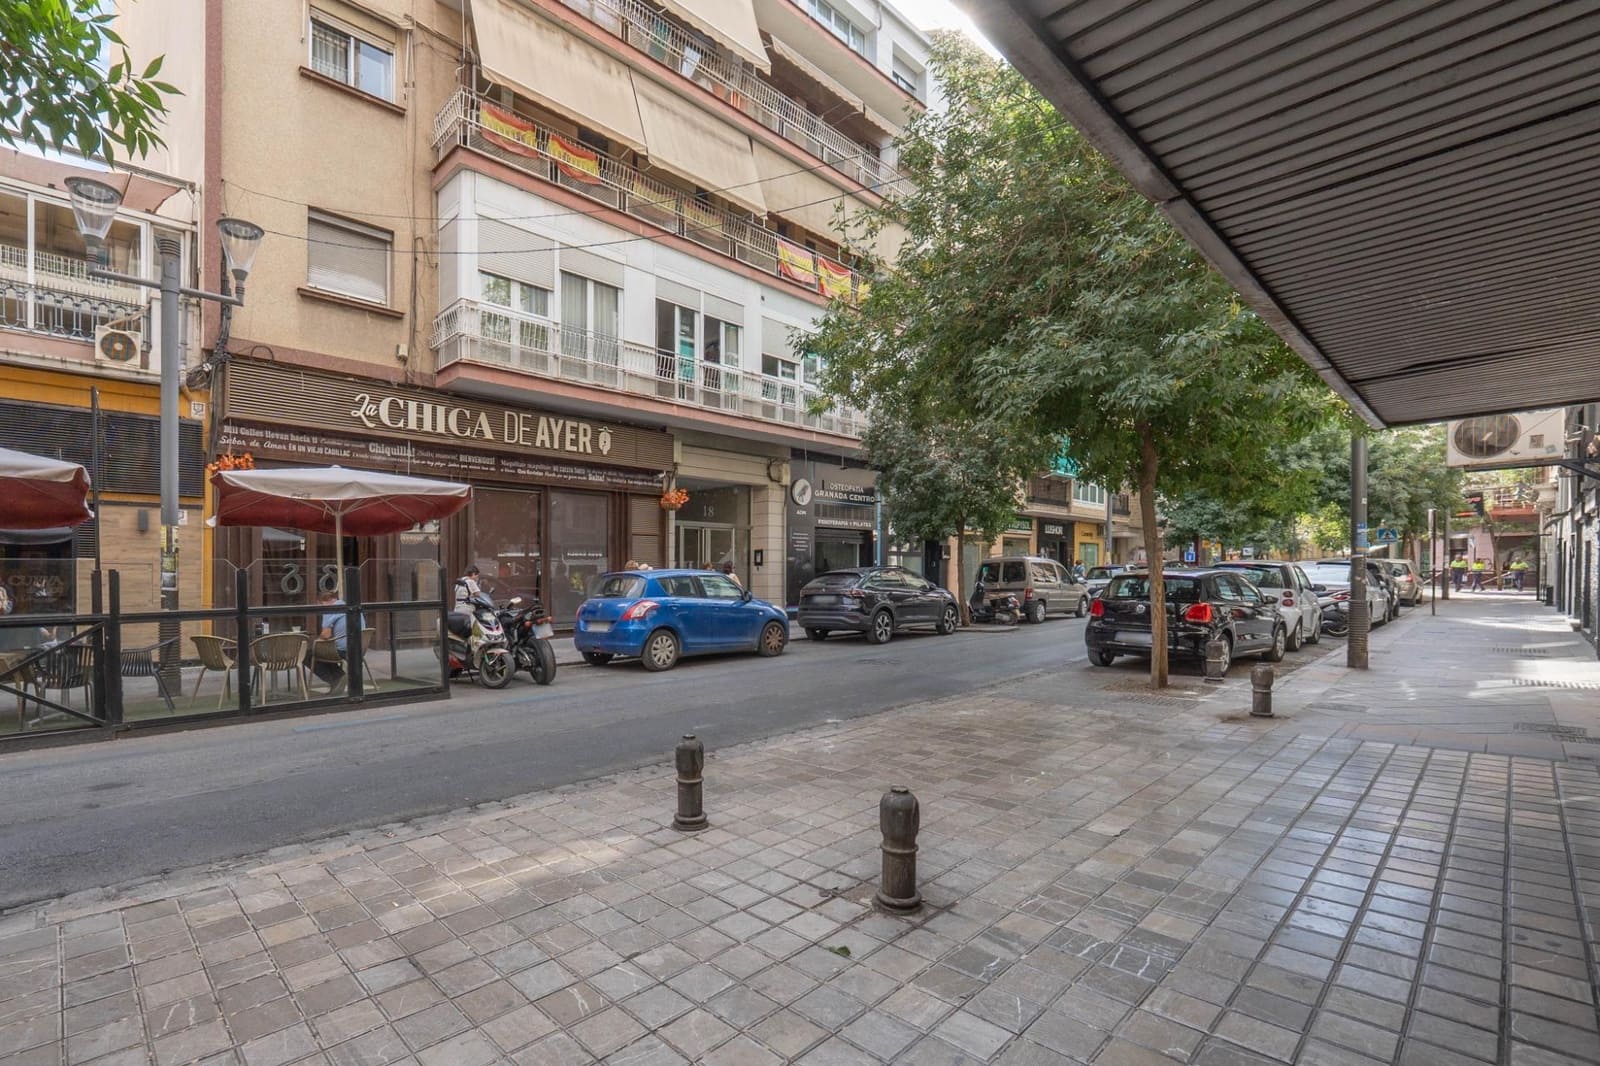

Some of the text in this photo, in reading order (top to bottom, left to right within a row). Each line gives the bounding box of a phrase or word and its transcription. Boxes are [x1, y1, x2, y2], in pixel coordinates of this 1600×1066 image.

[350, 393, 592, 454] La CHICA DE AYER
[249, 439, 260, 447] de
[814, 490, 875, 503] GRANADA CENTRO
[703, 504, 714, 517] 18
